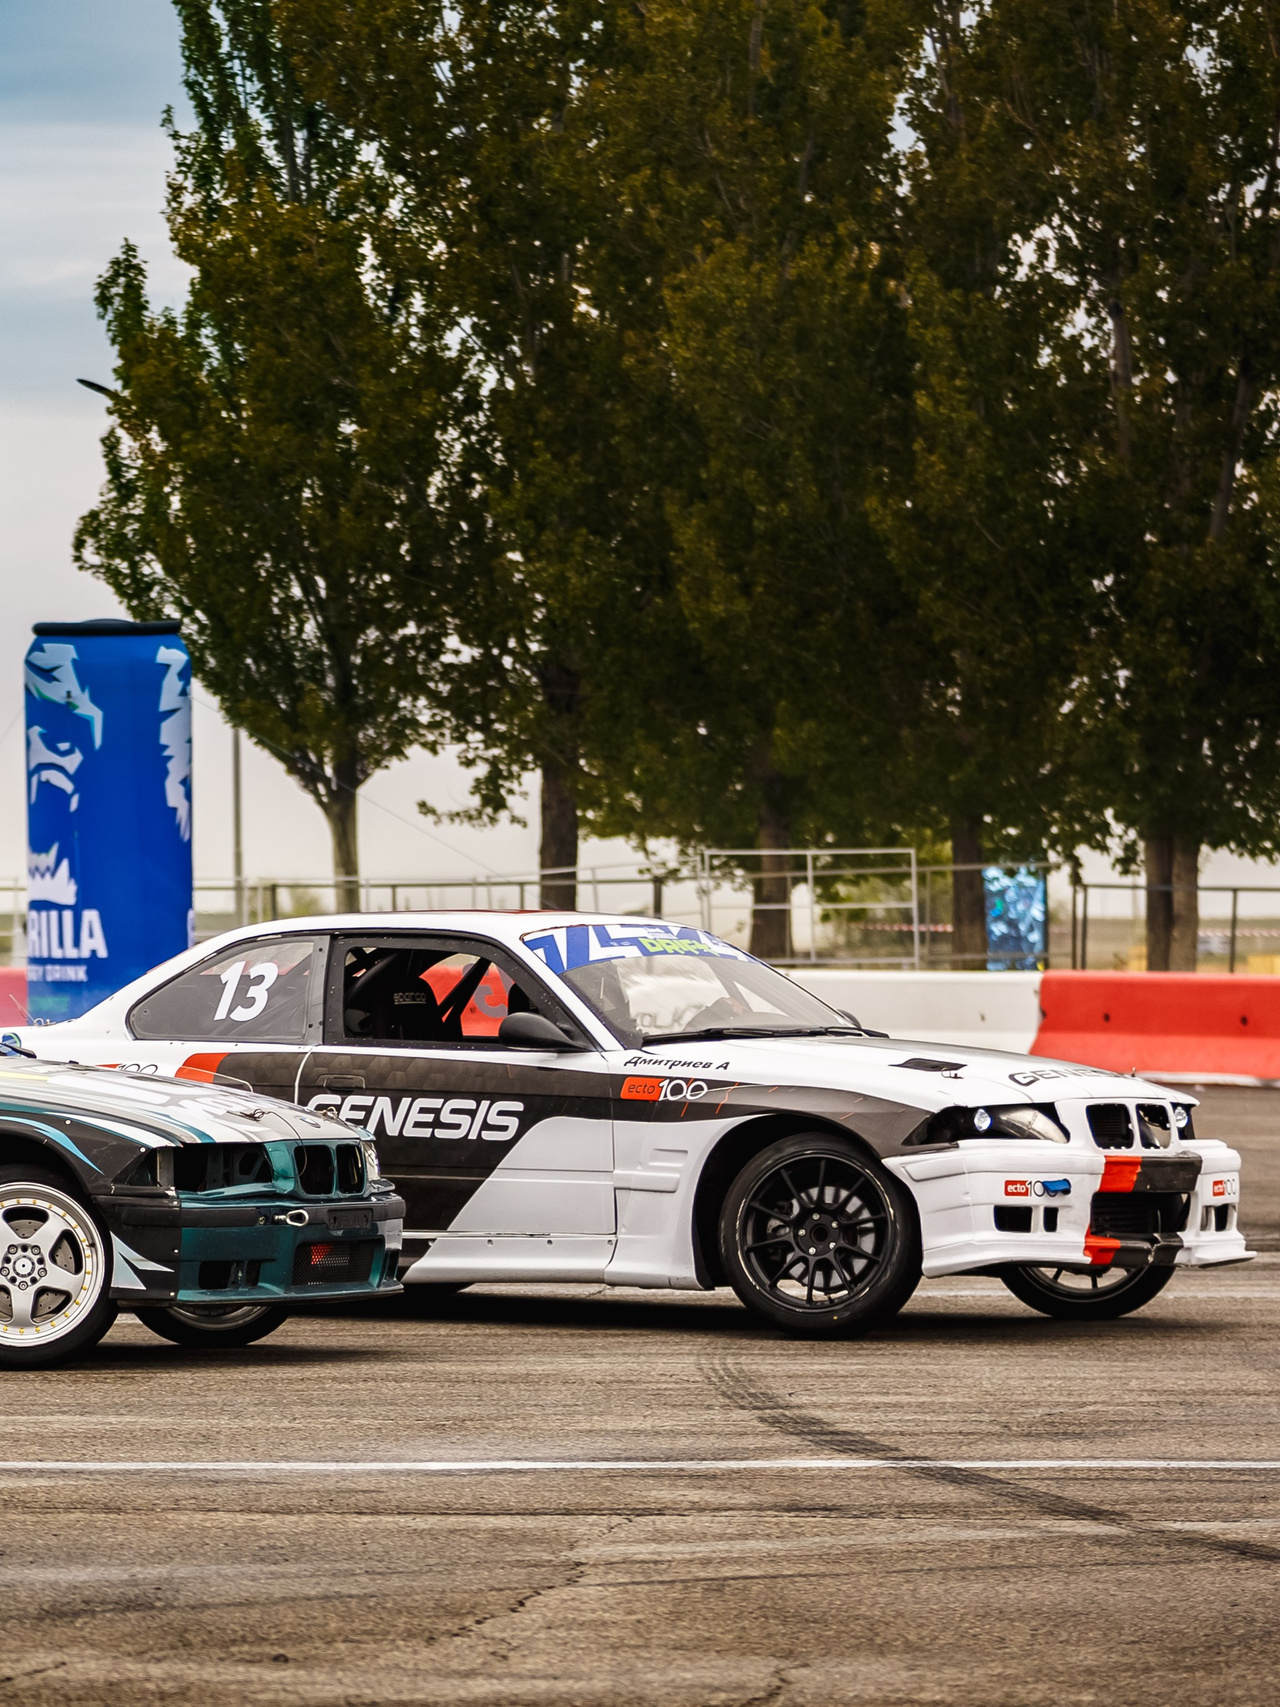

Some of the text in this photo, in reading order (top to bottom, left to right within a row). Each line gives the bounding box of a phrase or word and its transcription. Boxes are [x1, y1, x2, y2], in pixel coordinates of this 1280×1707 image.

[45, 964, 89, 982] DRINK
[213, 961, 279, 1022] 13
[393, 992, 427, 1005] sparco
[623, 1055, 713, 1070] Дмитриев
[1008, 1068, 1125, 1087] GENE
